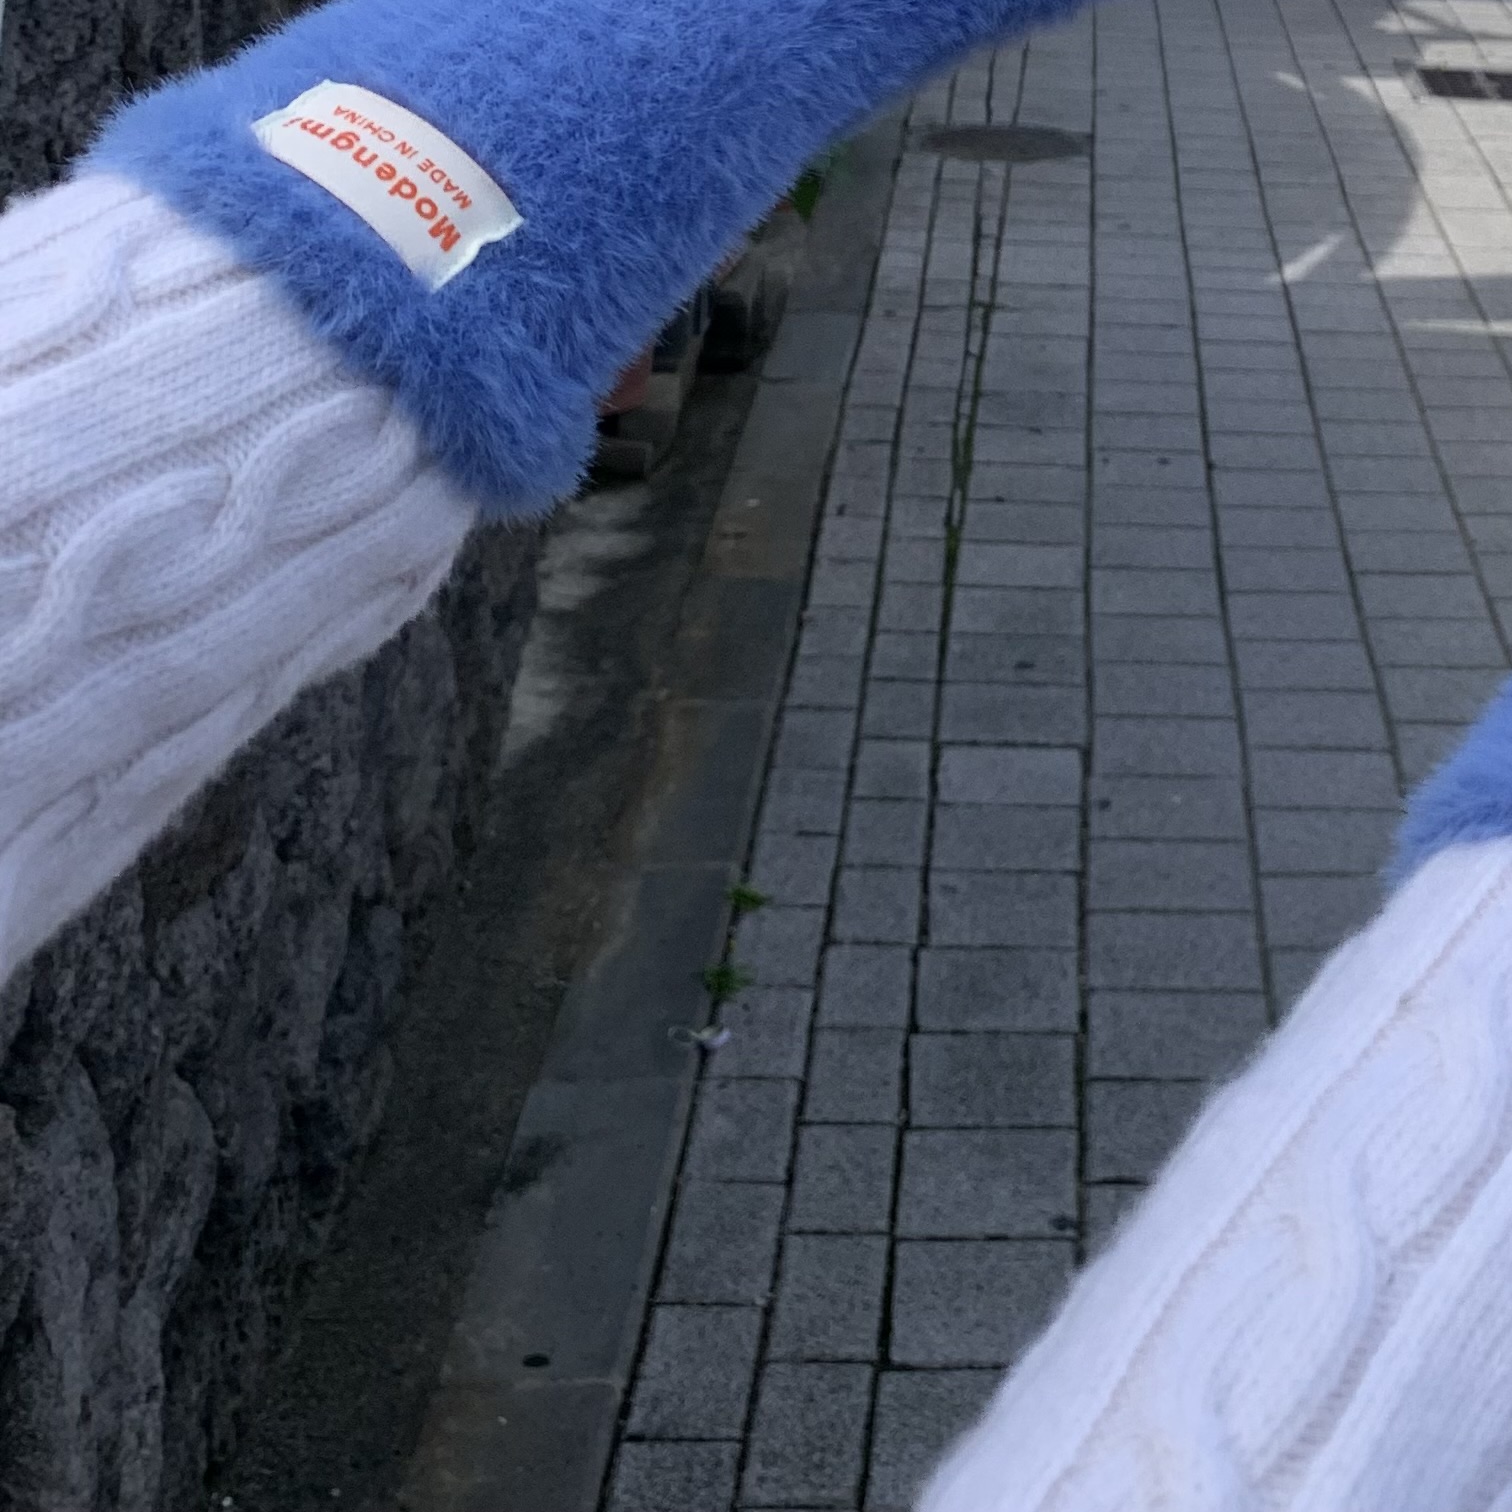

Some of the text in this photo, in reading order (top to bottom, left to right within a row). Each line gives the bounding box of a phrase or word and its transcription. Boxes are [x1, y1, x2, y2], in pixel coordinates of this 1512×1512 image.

[281, 116, 462, 254] Modengmi
[332, 104, 472, 211] MADE IN CHINA
